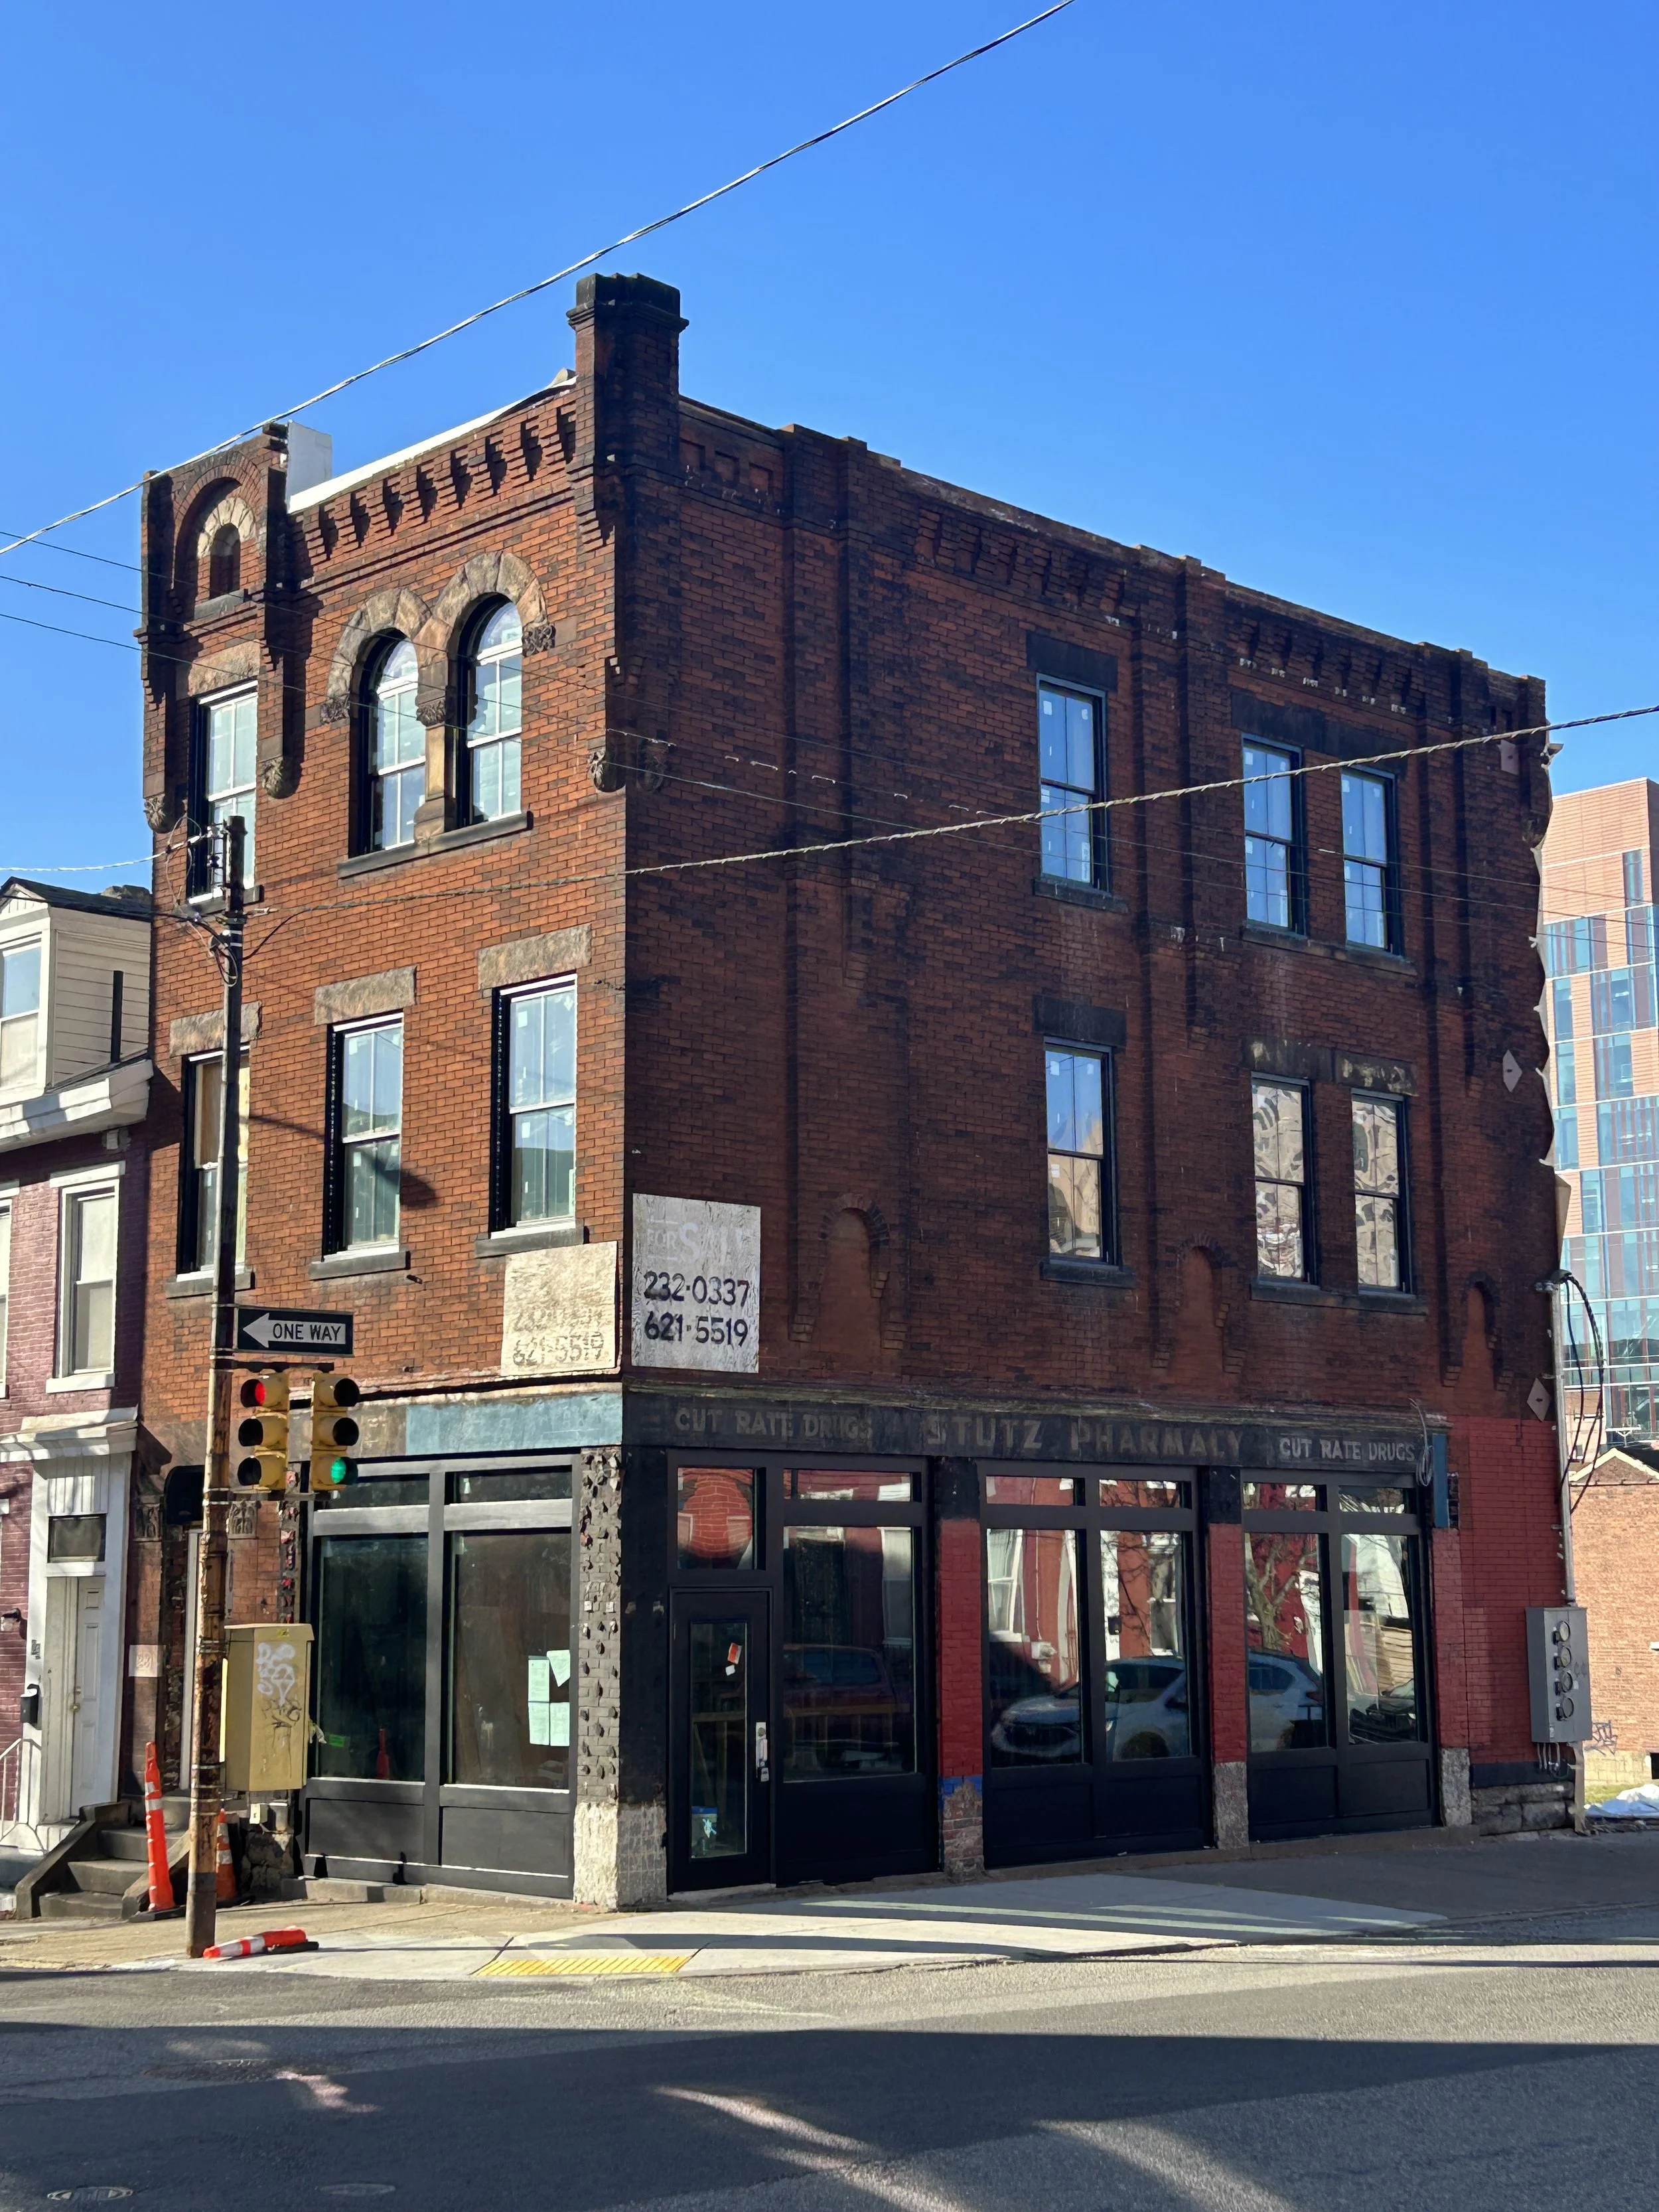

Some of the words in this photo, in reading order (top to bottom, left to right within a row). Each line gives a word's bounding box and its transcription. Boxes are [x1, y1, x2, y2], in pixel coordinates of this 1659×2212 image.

[273, 1323, 304, 1340] ONE
[309, 1324, 341, 1342] WAY
[674, 1407, 721, 1433] CUT
[735, 1410, 794, 1438] RATE
[802, 1413, 873, 1440] DRUGS
[924, 1414, 1045, 1451] STUTZ
[1070, 1421, 1244, 1460] PHARMACY
[1278, 1437, 1313, 1458] CUT
[1319, 1438, 1362, 1460] RATE
[1368, 1441, 1415, 1462] DRUGS
